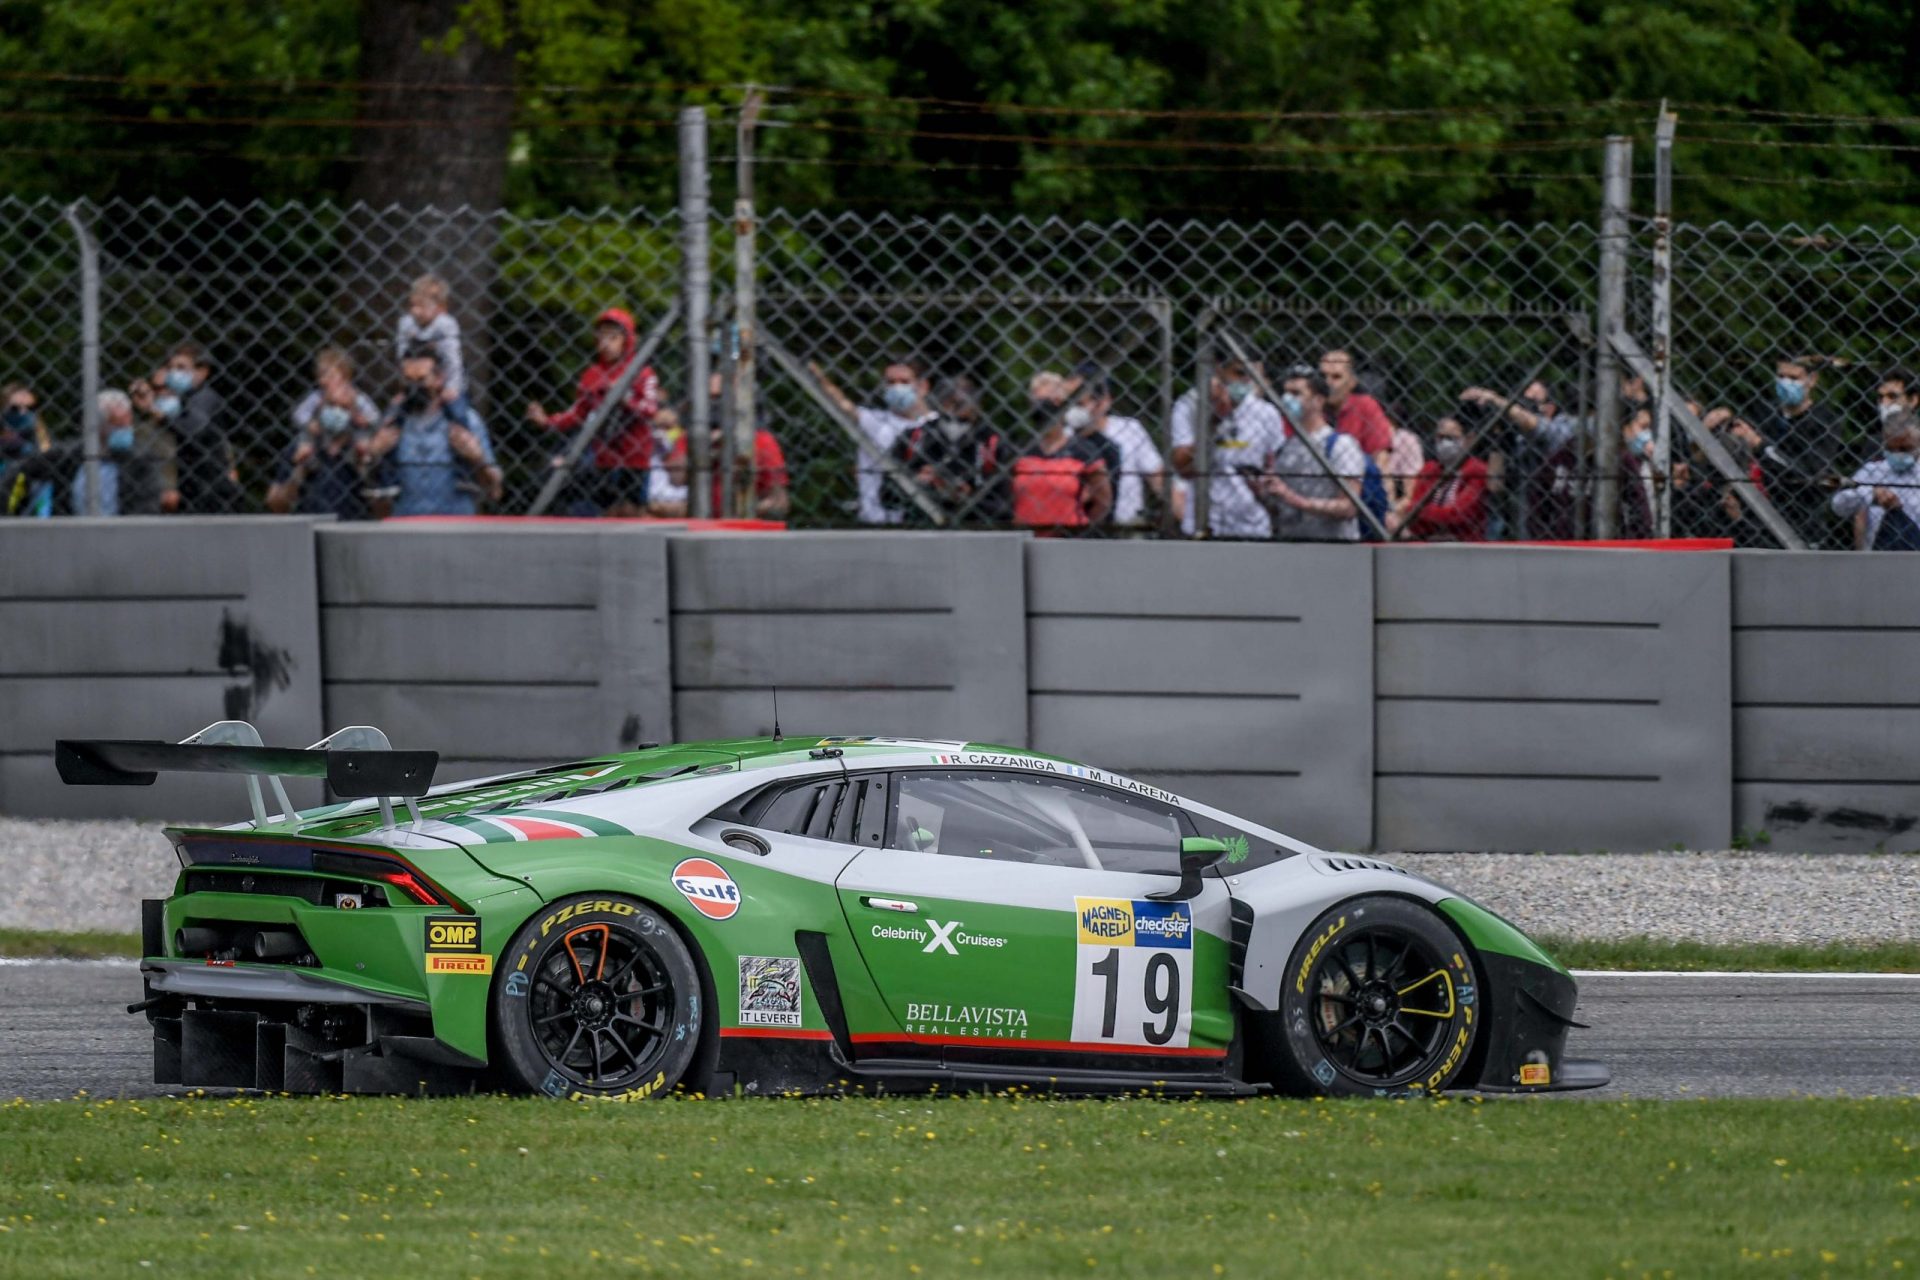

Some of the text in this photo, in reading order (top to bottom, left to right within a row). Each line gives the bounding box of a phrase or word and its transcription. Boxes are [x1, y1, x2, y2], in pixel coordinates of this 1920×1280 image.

[949, 753, 1057, 772] R. CAZZANIGA
[1089, 769, 1181, 806] M. LLARENA
[675, 879, 737, 901] Gulf
[1135, 915, 1190, 933] checkstar
[429, 926, 477, 943] OMP
[871, 918, 1004, 956] Celebrity X Cruises
[433, 957, 486, 971] PIRELLI
[1296, 916, 1346, 993] PIRELLI
[1091, 947, 1181, 1046] 19
[741, 1012, 800, 1024] IT LEVERET
[906, 1003, 1029, 1027] BELLAVISTA
[906, 1024, 1028, 1039] REAL ESTATE
